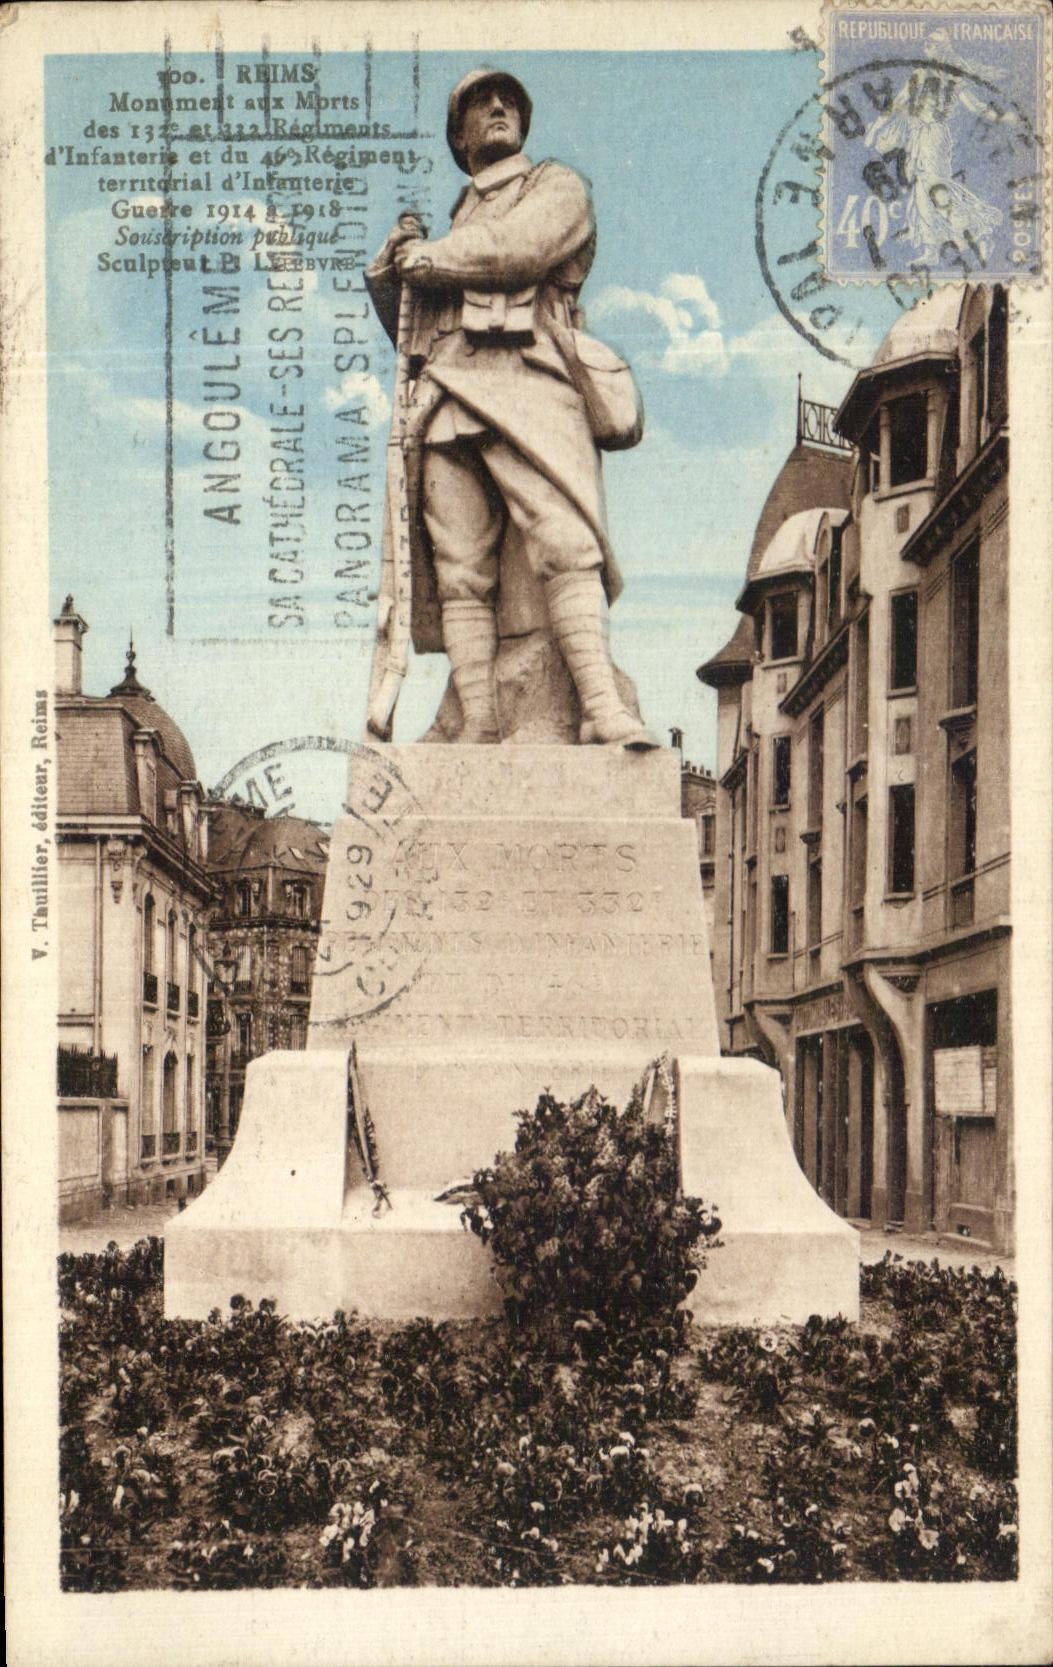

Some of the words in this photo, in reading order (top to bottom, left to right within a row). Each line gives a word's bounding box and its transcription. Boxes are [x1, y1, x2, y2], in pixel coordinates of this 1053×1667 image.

[334, 405, 373, 629] PANORAMA
[267, 596, 305, 630] SA
[390, 841, 470, 873] AUX
[493, 841, 640, 875] MORTS
